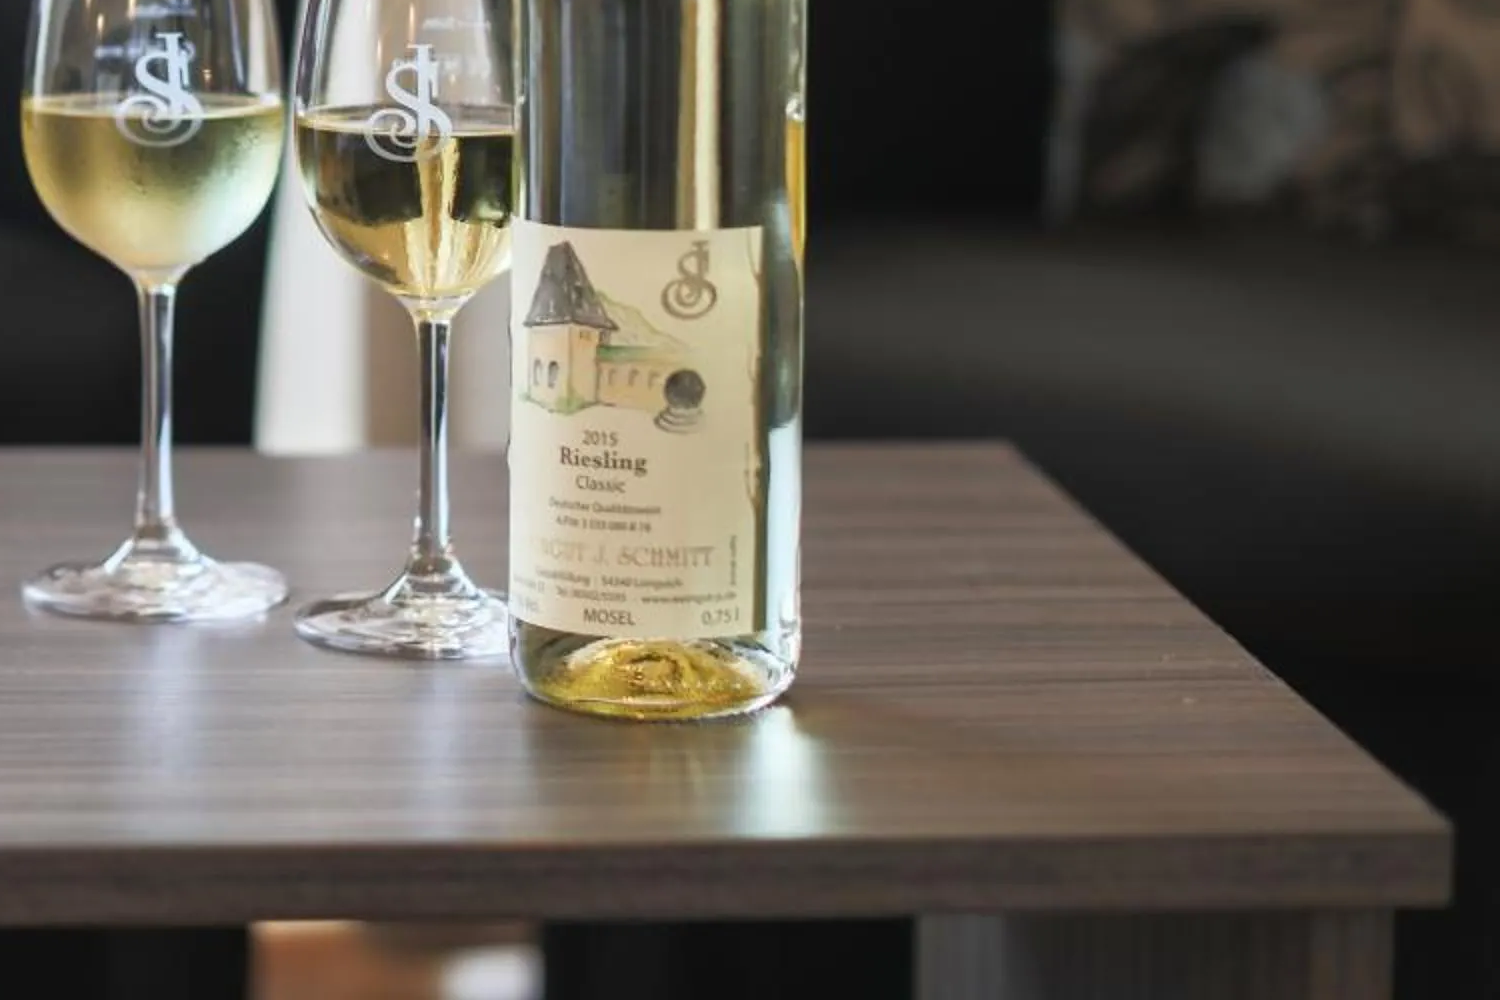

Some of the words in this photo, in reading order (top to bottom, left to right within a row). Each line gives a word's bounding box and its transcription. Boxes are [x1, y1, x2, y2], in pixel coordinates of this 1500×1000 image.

[582, 430, 619, 447] 2015
[560, 446, 648, 477] Riesling
[575, 475, 626, 494] Classic
[617, 545, 716, 569] SCHMITT
[583, 608, 636, 626] MOSEL
